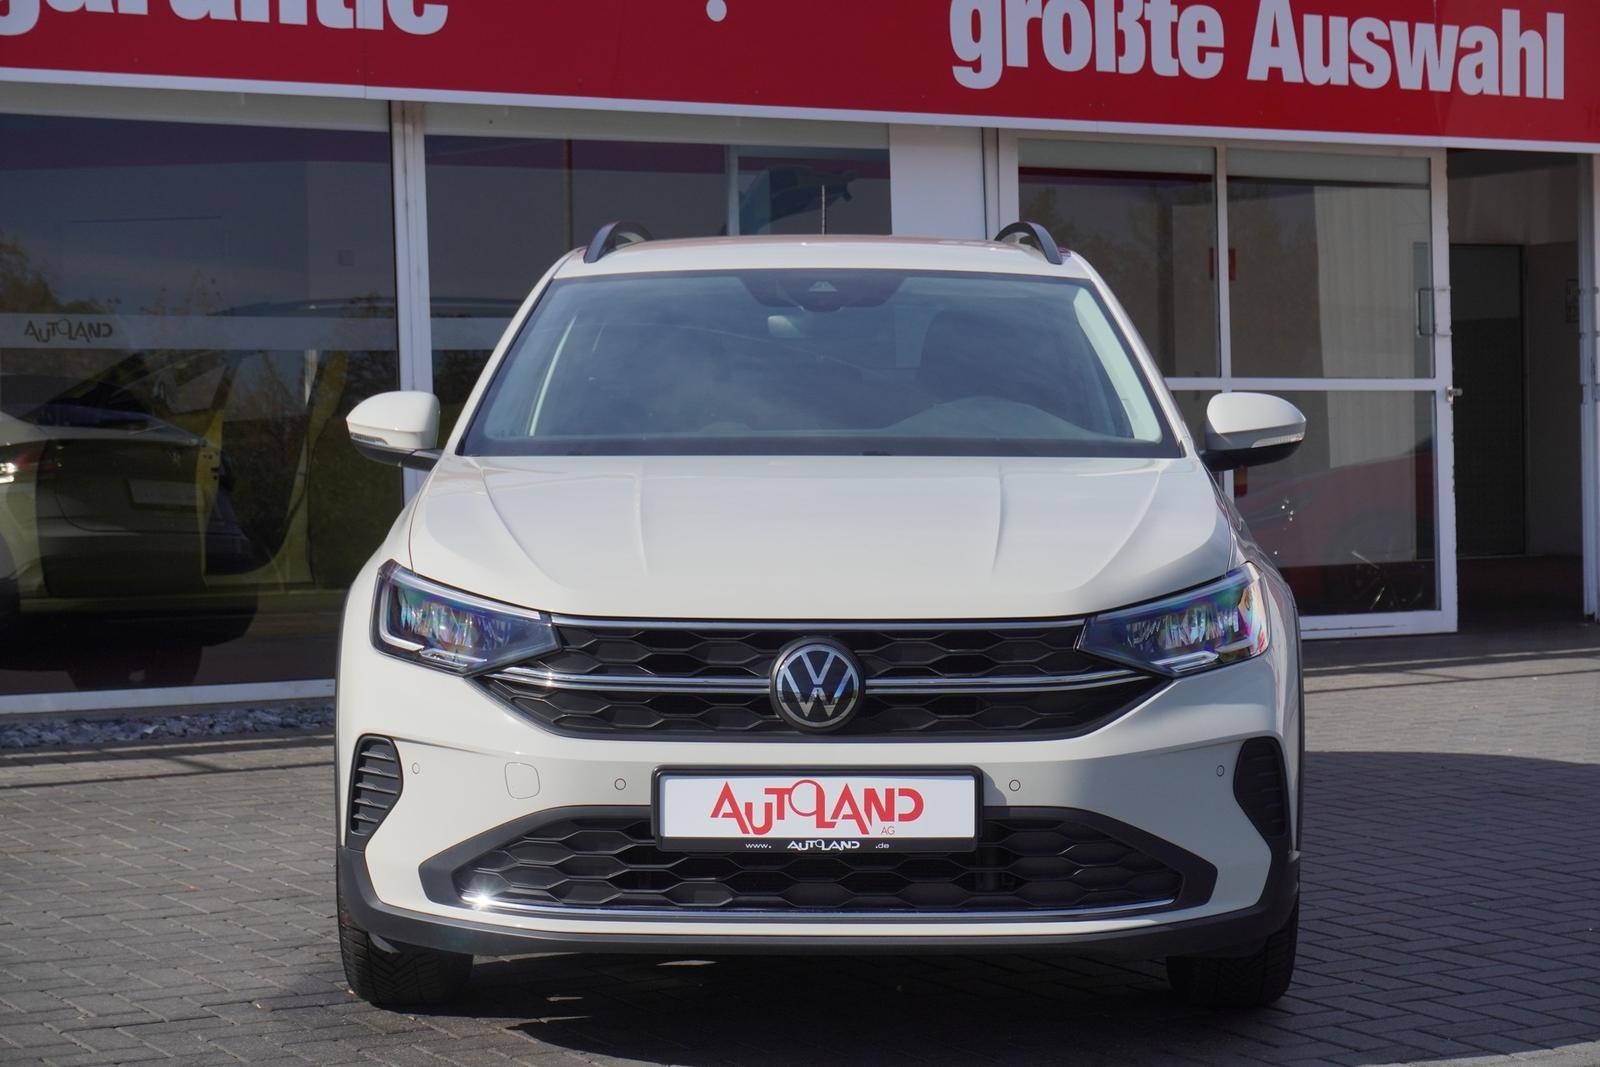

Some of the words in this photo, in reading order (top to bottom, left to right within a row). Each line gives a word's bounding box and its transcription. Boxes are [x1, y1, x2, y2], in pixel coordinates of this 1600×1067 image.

[1247, 0, 1565, 100] Auswahl
[777, 644, 859, 727] VW
[710, 779, 925, 836] AUTOLAND
[880, 825, 896, 836] AG
[744, 842, 773, 850] www.
[786, 838, 861, 851] AUTOLAND
[874, 841, 891, 850] .de
